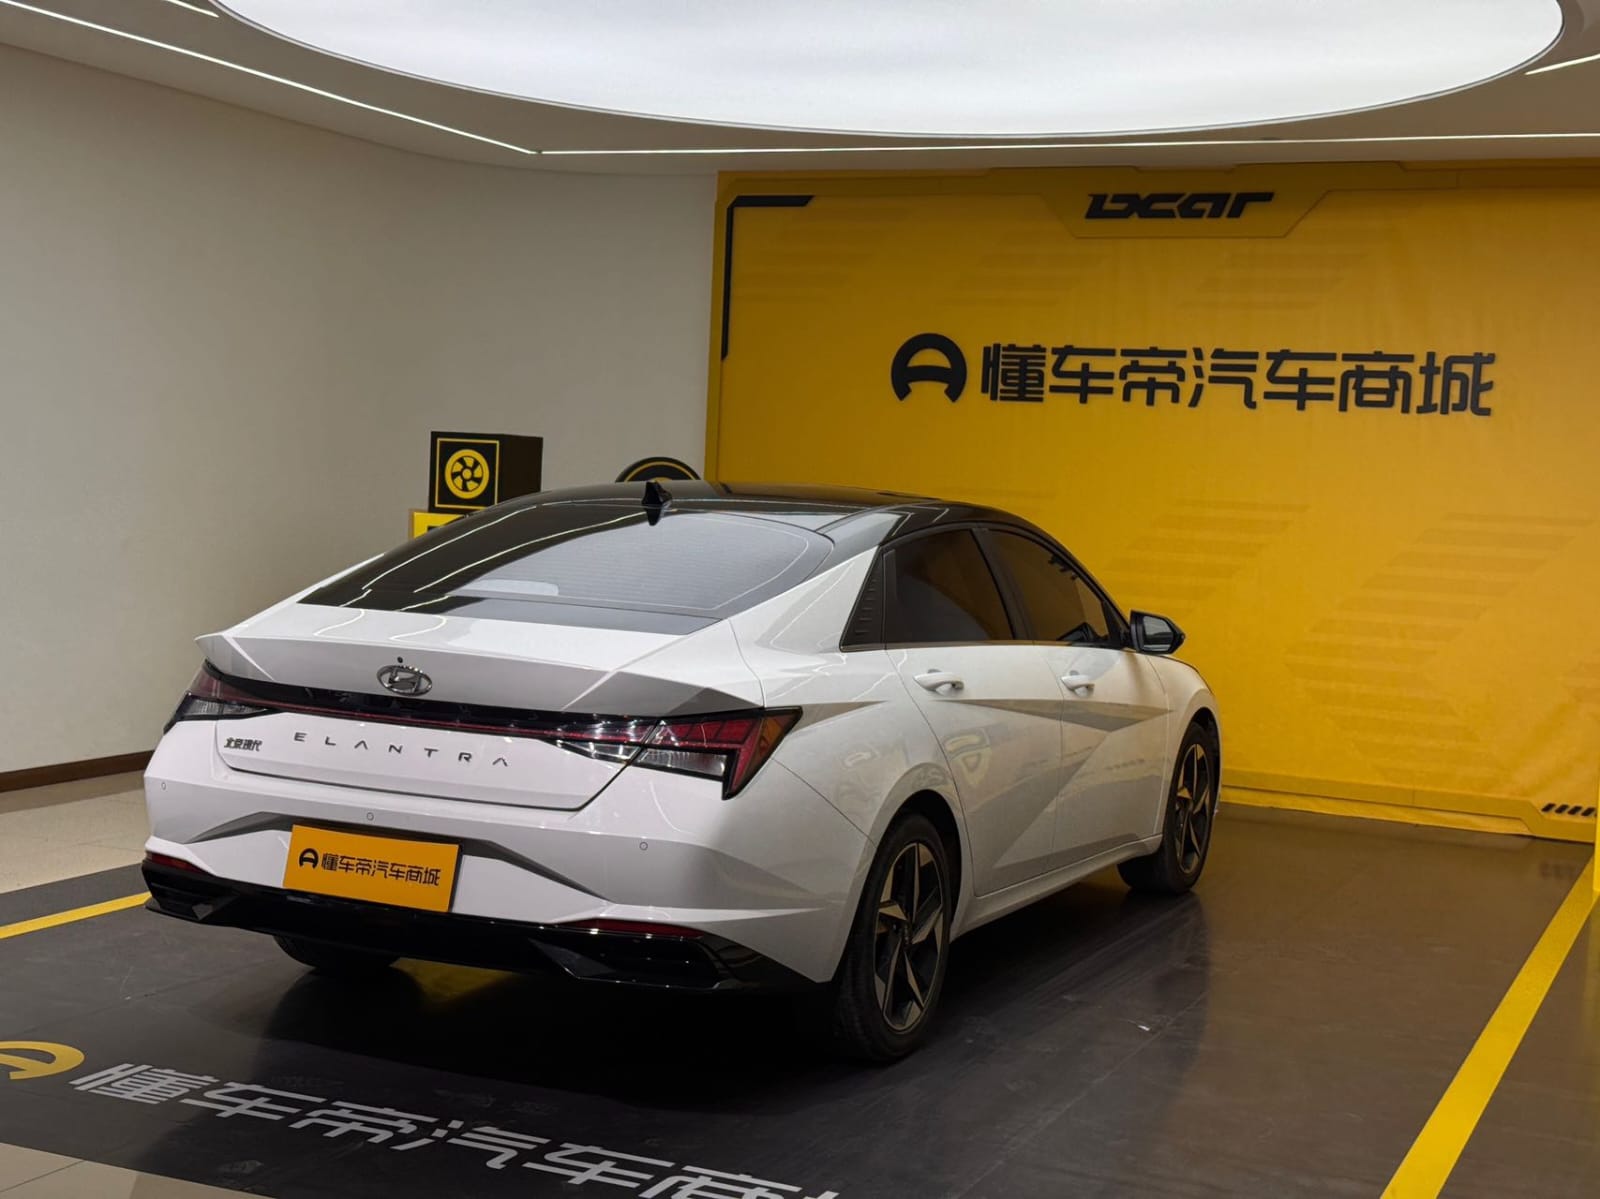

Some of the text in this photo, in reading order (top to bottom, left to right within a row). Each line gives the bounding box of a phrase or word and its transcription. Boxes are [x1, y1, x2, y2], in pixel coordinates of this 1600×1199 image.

[981, 343, 1496, 416] 懂车帝汽车商城
[293, 732, 509, 767] ELANTRA
[321, 852, 442, 887] 懂车帝汽车商城
[68, 1063, 839, 1199] 懂车帝汽车商
